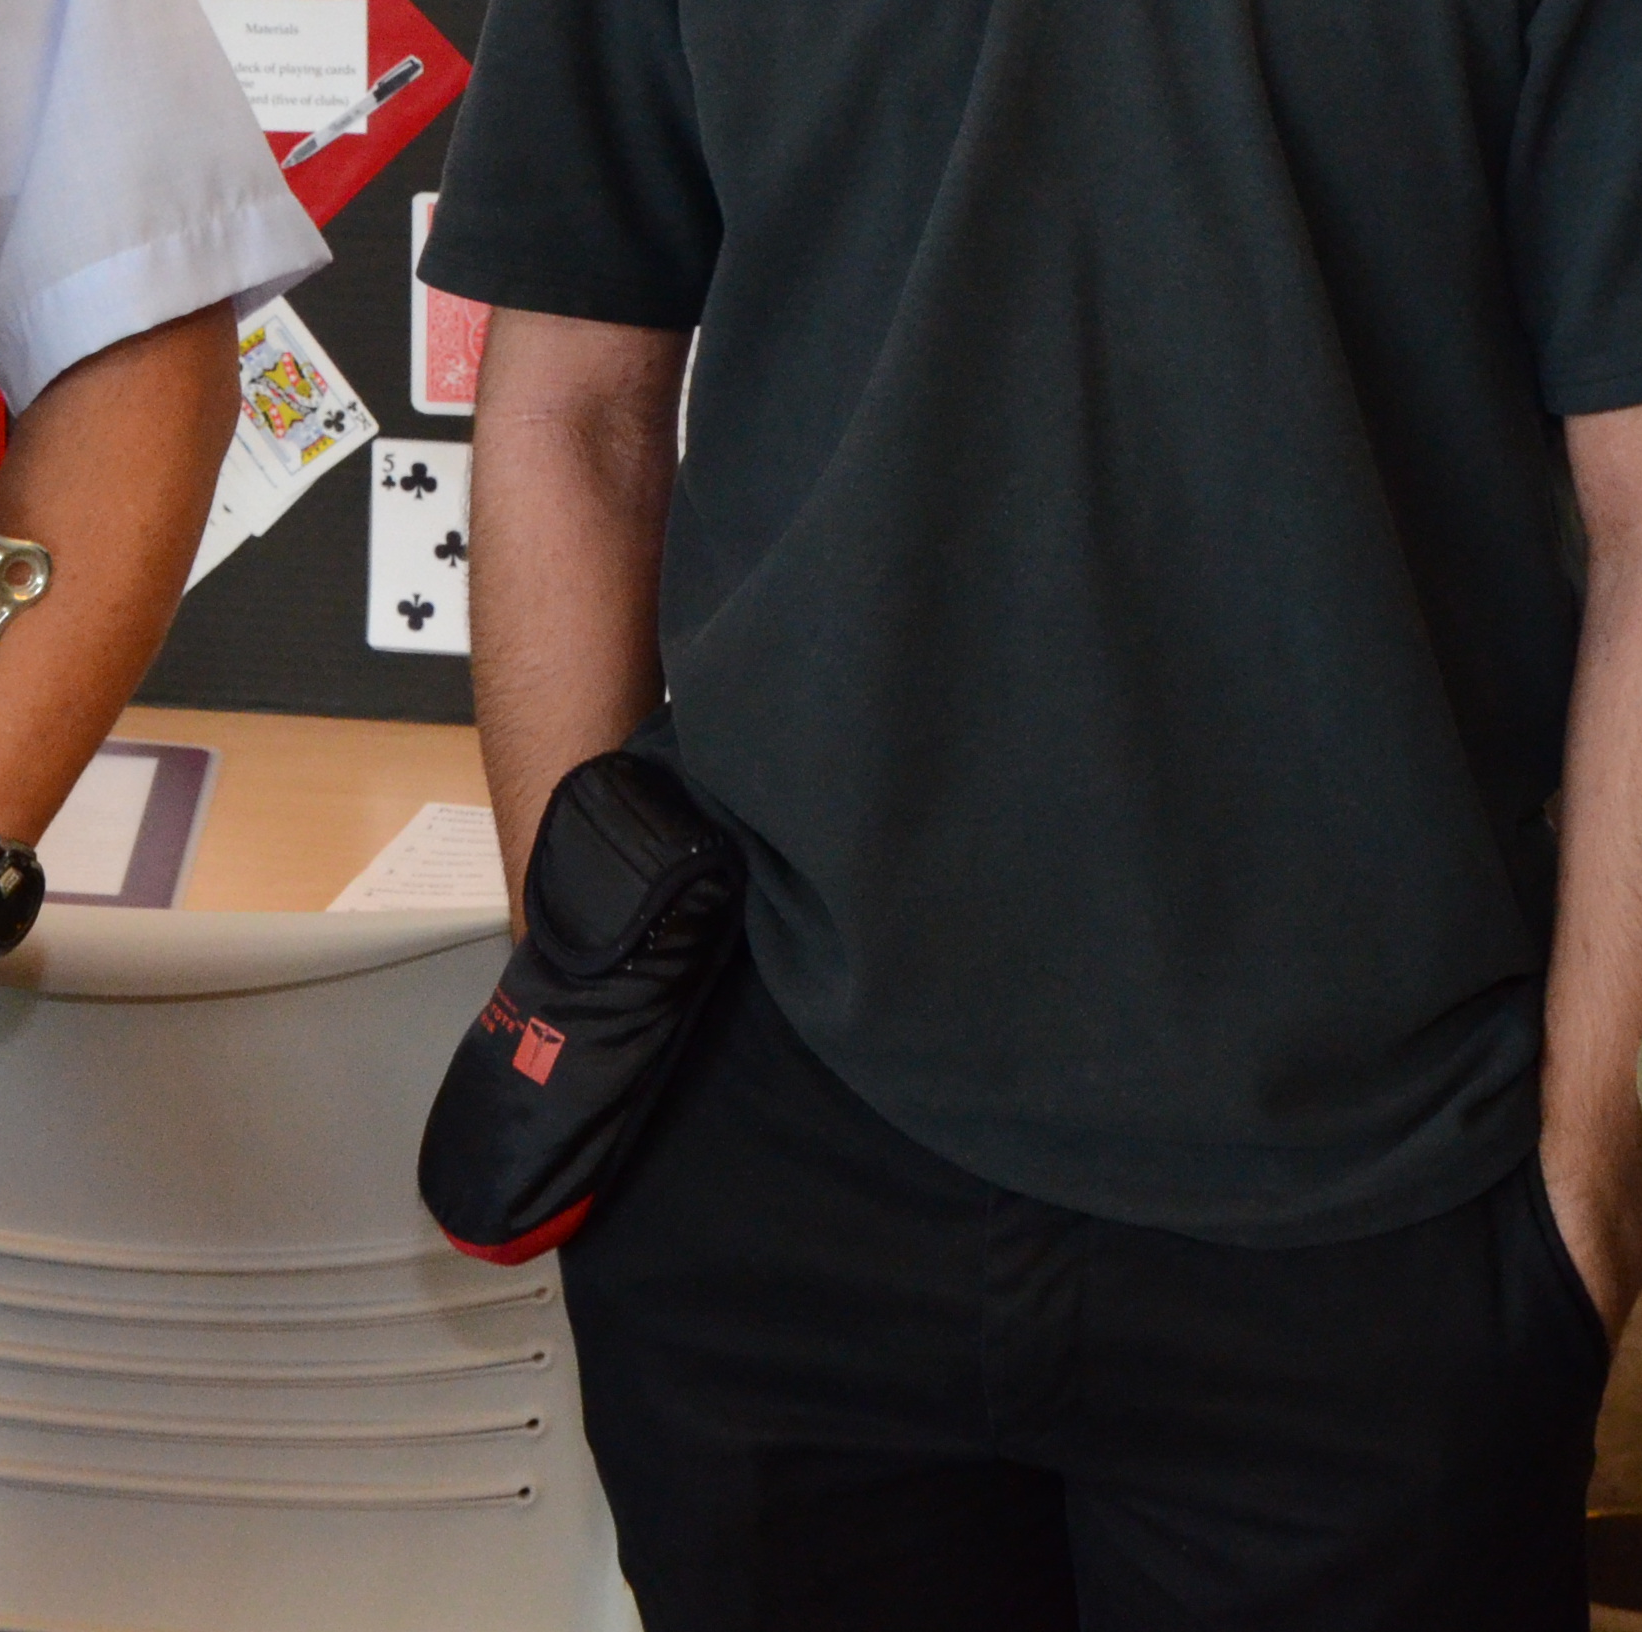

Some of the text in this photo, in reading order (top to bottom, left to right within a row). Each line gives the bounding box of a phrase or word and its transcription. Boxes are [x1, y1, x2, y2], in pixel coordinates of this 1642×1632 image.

[246, 23, 299, 36] Materials
[279, 64, 357, 78] playing cards
[383, 454, 395, 472] 5
